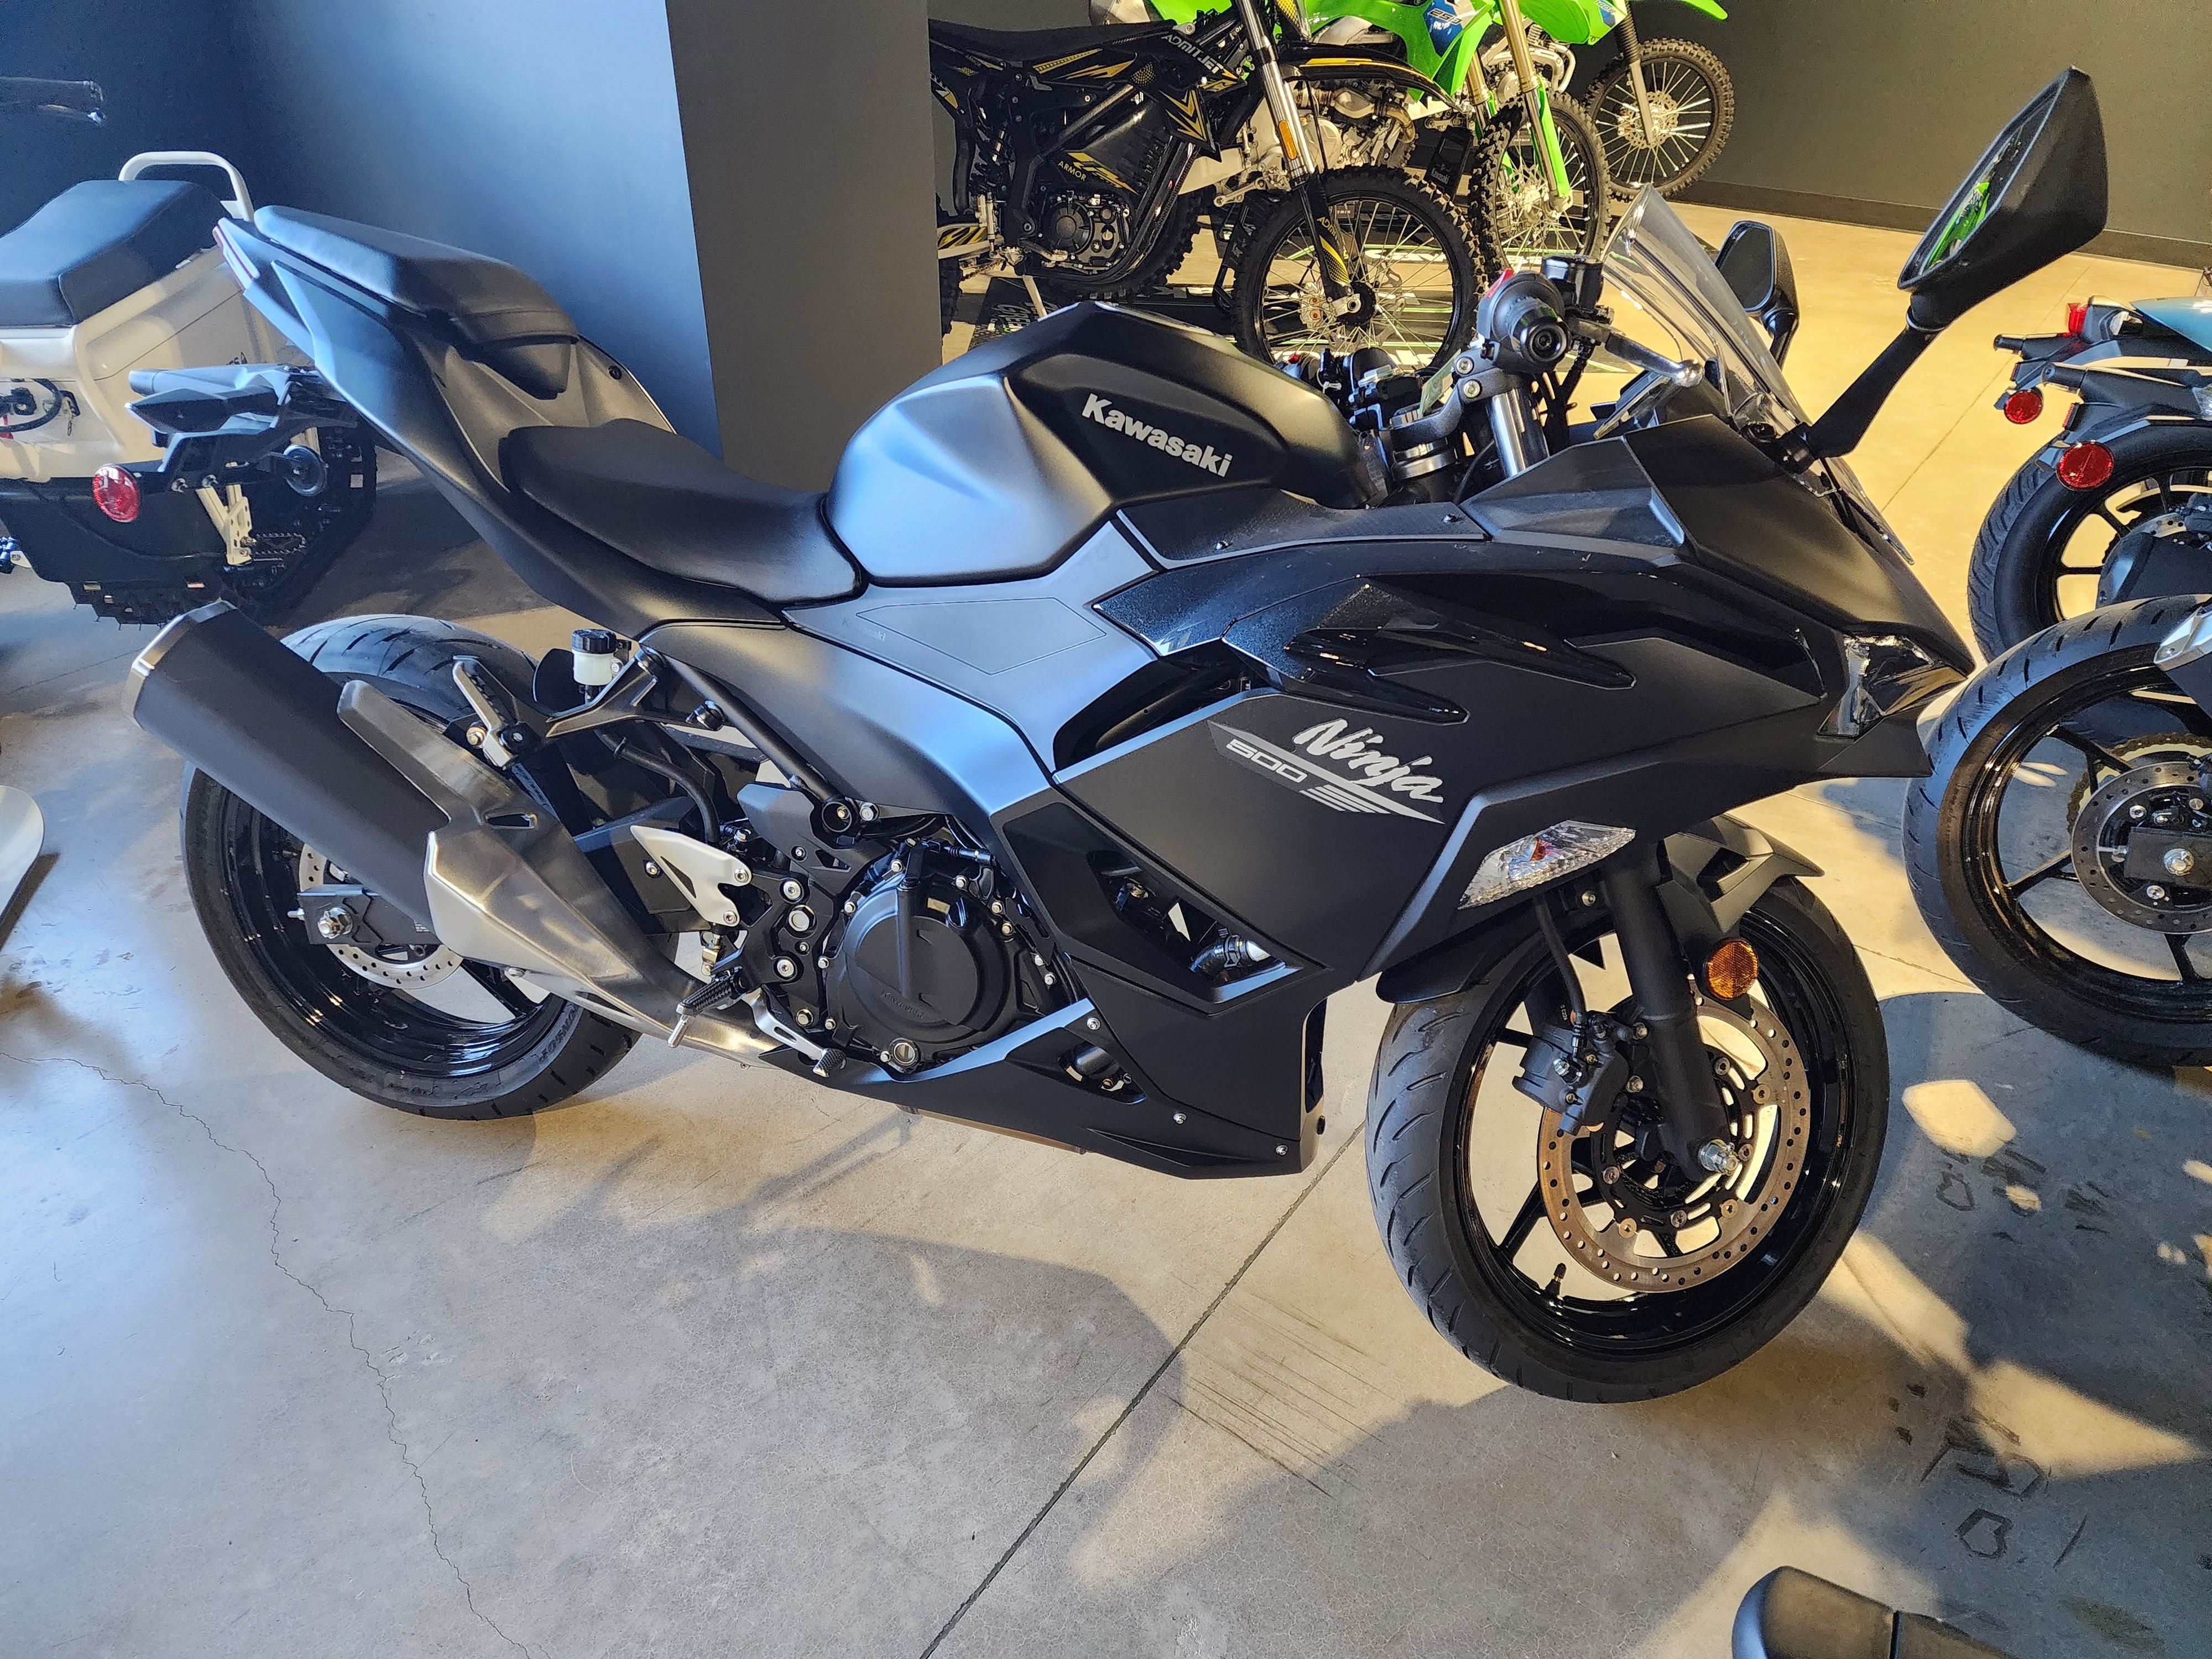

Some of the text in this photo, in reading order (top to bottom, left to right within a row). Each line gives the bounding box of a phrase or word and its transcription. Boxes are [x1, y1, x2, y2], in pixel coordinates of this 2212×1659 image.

[1161, 34, 1224, 74] ADMITJET
[1057, 160, 1087, 181] ARMOR
[1081, 393, 1233, 478] Kawasaki
[842, 617, 886, 641] Kasaki
[1226, 739, 1308, 784] 500
[1293, 718, 1444, 804] Ninja
